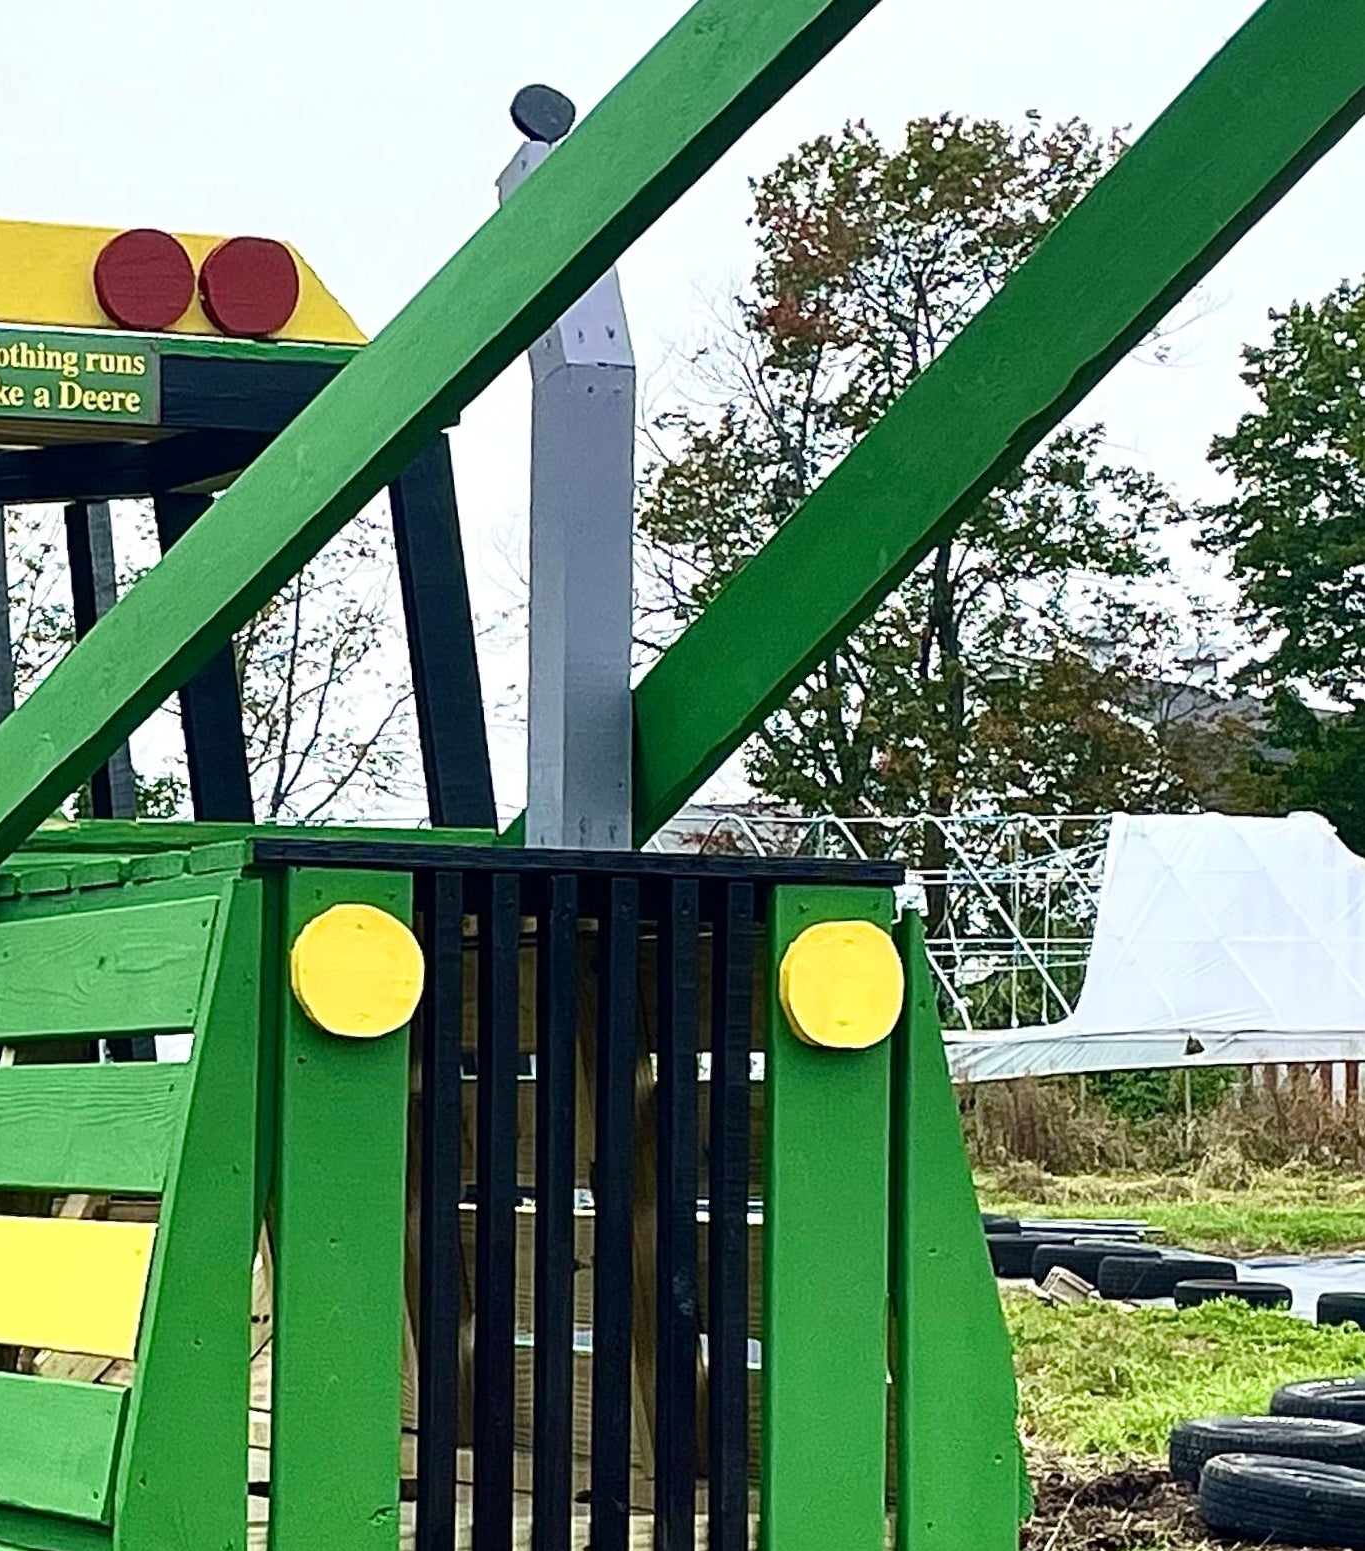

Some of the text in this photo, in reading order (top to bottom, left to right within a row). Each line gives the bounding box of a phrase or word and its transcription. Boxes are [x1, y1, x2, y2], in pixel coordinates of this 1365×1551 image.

[85, 351, 146, 376] runs
[33, 386, 51, 407] a
[57, 381, 141, 412] Deere
